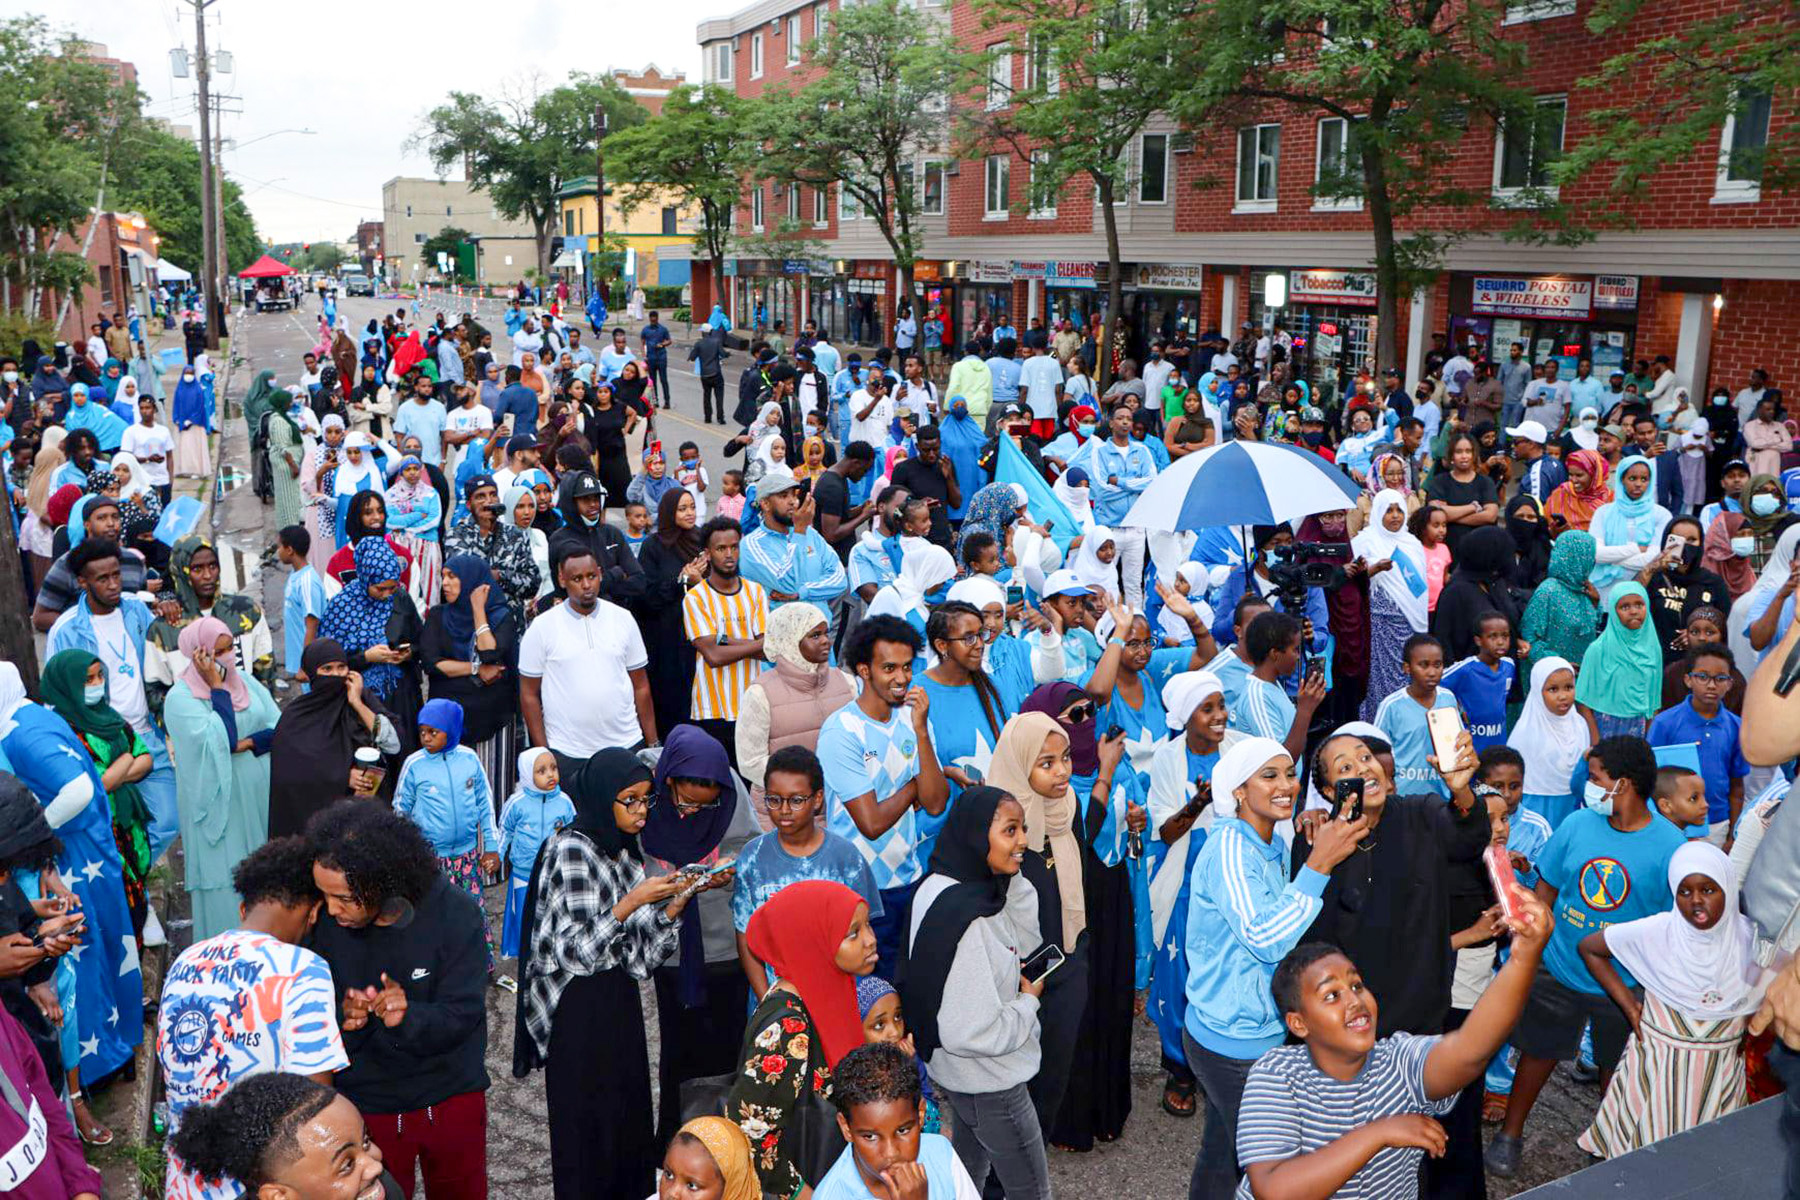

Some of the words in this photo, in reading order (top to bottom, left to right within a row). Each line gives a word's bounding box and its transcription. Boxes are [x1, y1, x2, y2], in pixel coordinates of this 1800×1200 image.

[1057, 261, 1096, 278] CLEANERS
[1150, 265, 1200, 278] ROCHESTER
[1476, 279, 1526, 292] SEWARD
[1529, 281, 1589, 295] POSTAL
[1480, 291, 1492, 302] &
[1495, 292, 1571, 308] WIRELESS
[198, 944, 240, 961] NIKE
[212, 960, 264, 987] PARTY
[222, 1032, 261, 1047] GAMES
